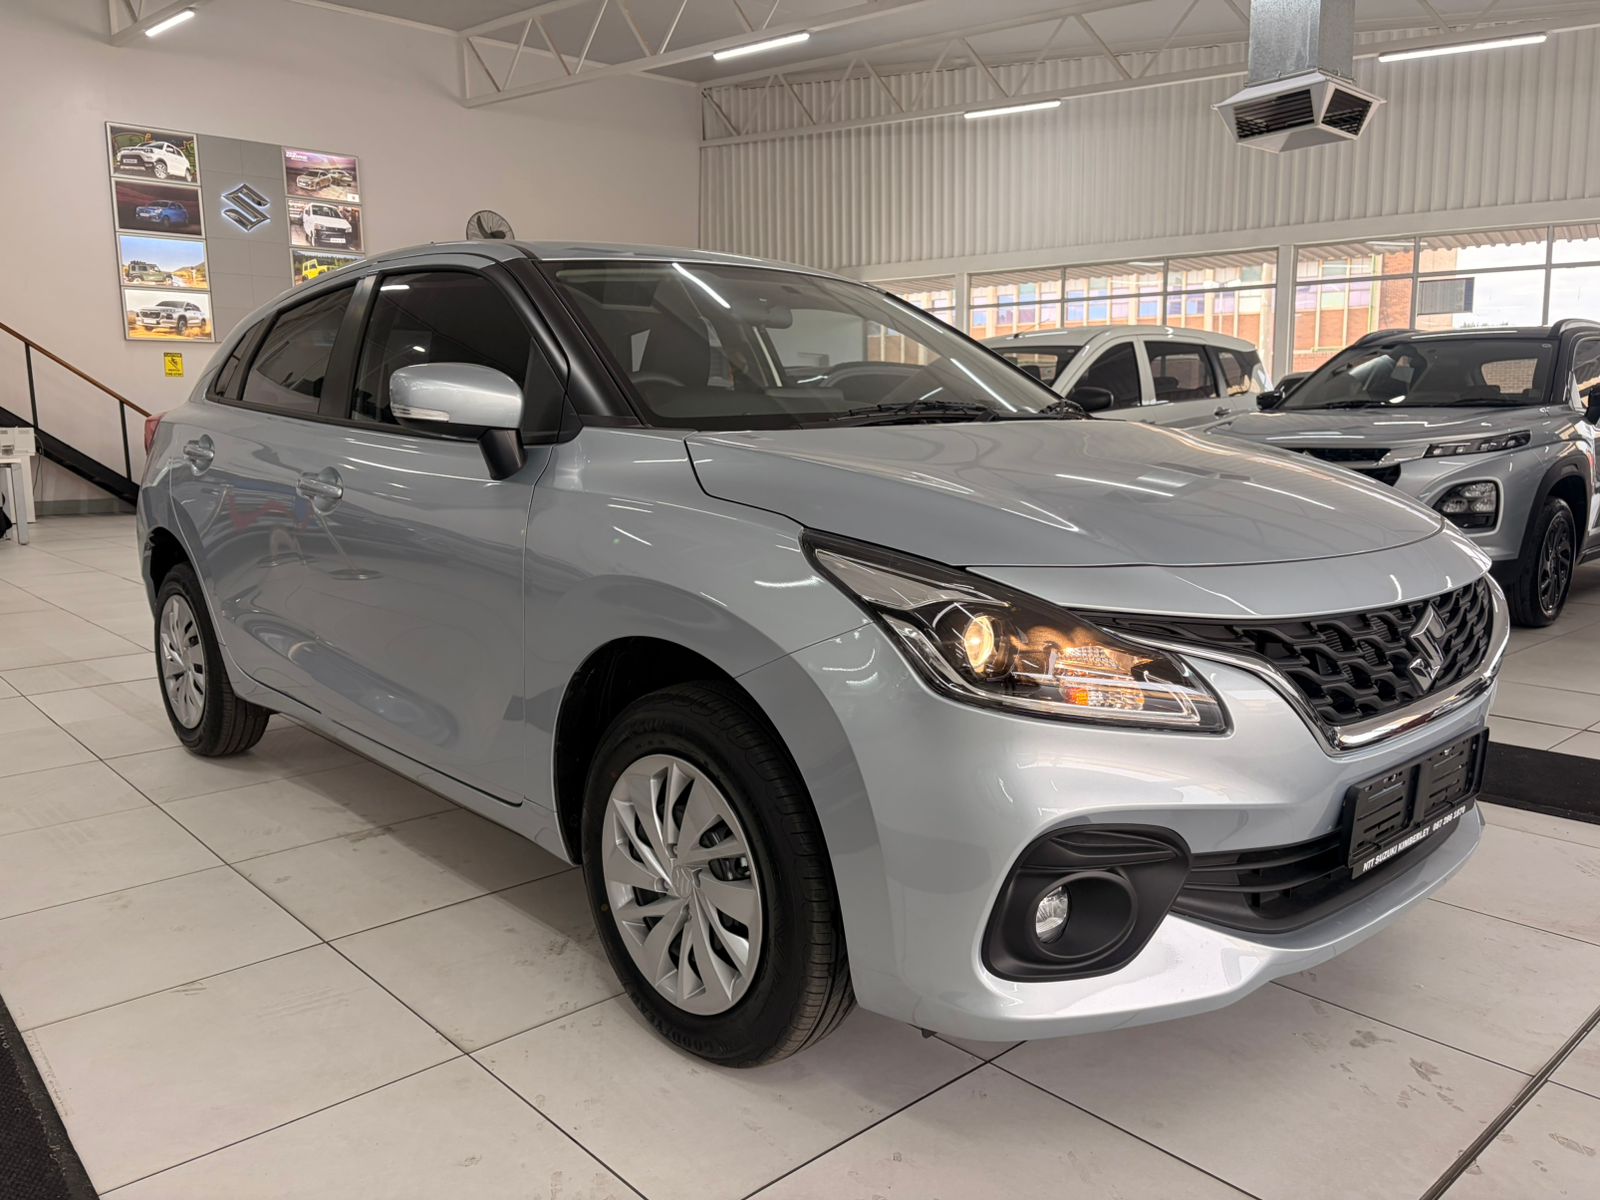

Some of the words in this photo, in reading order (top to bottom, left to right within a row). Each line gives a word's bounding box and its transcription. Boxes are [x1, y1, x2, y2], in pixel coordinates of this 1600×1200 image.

[1363, 857, 1375, 872] NTT
[1375, 844, 1398, 865] SUZUKI
[1398, 826, 1430, 852] KIMBERLEY
